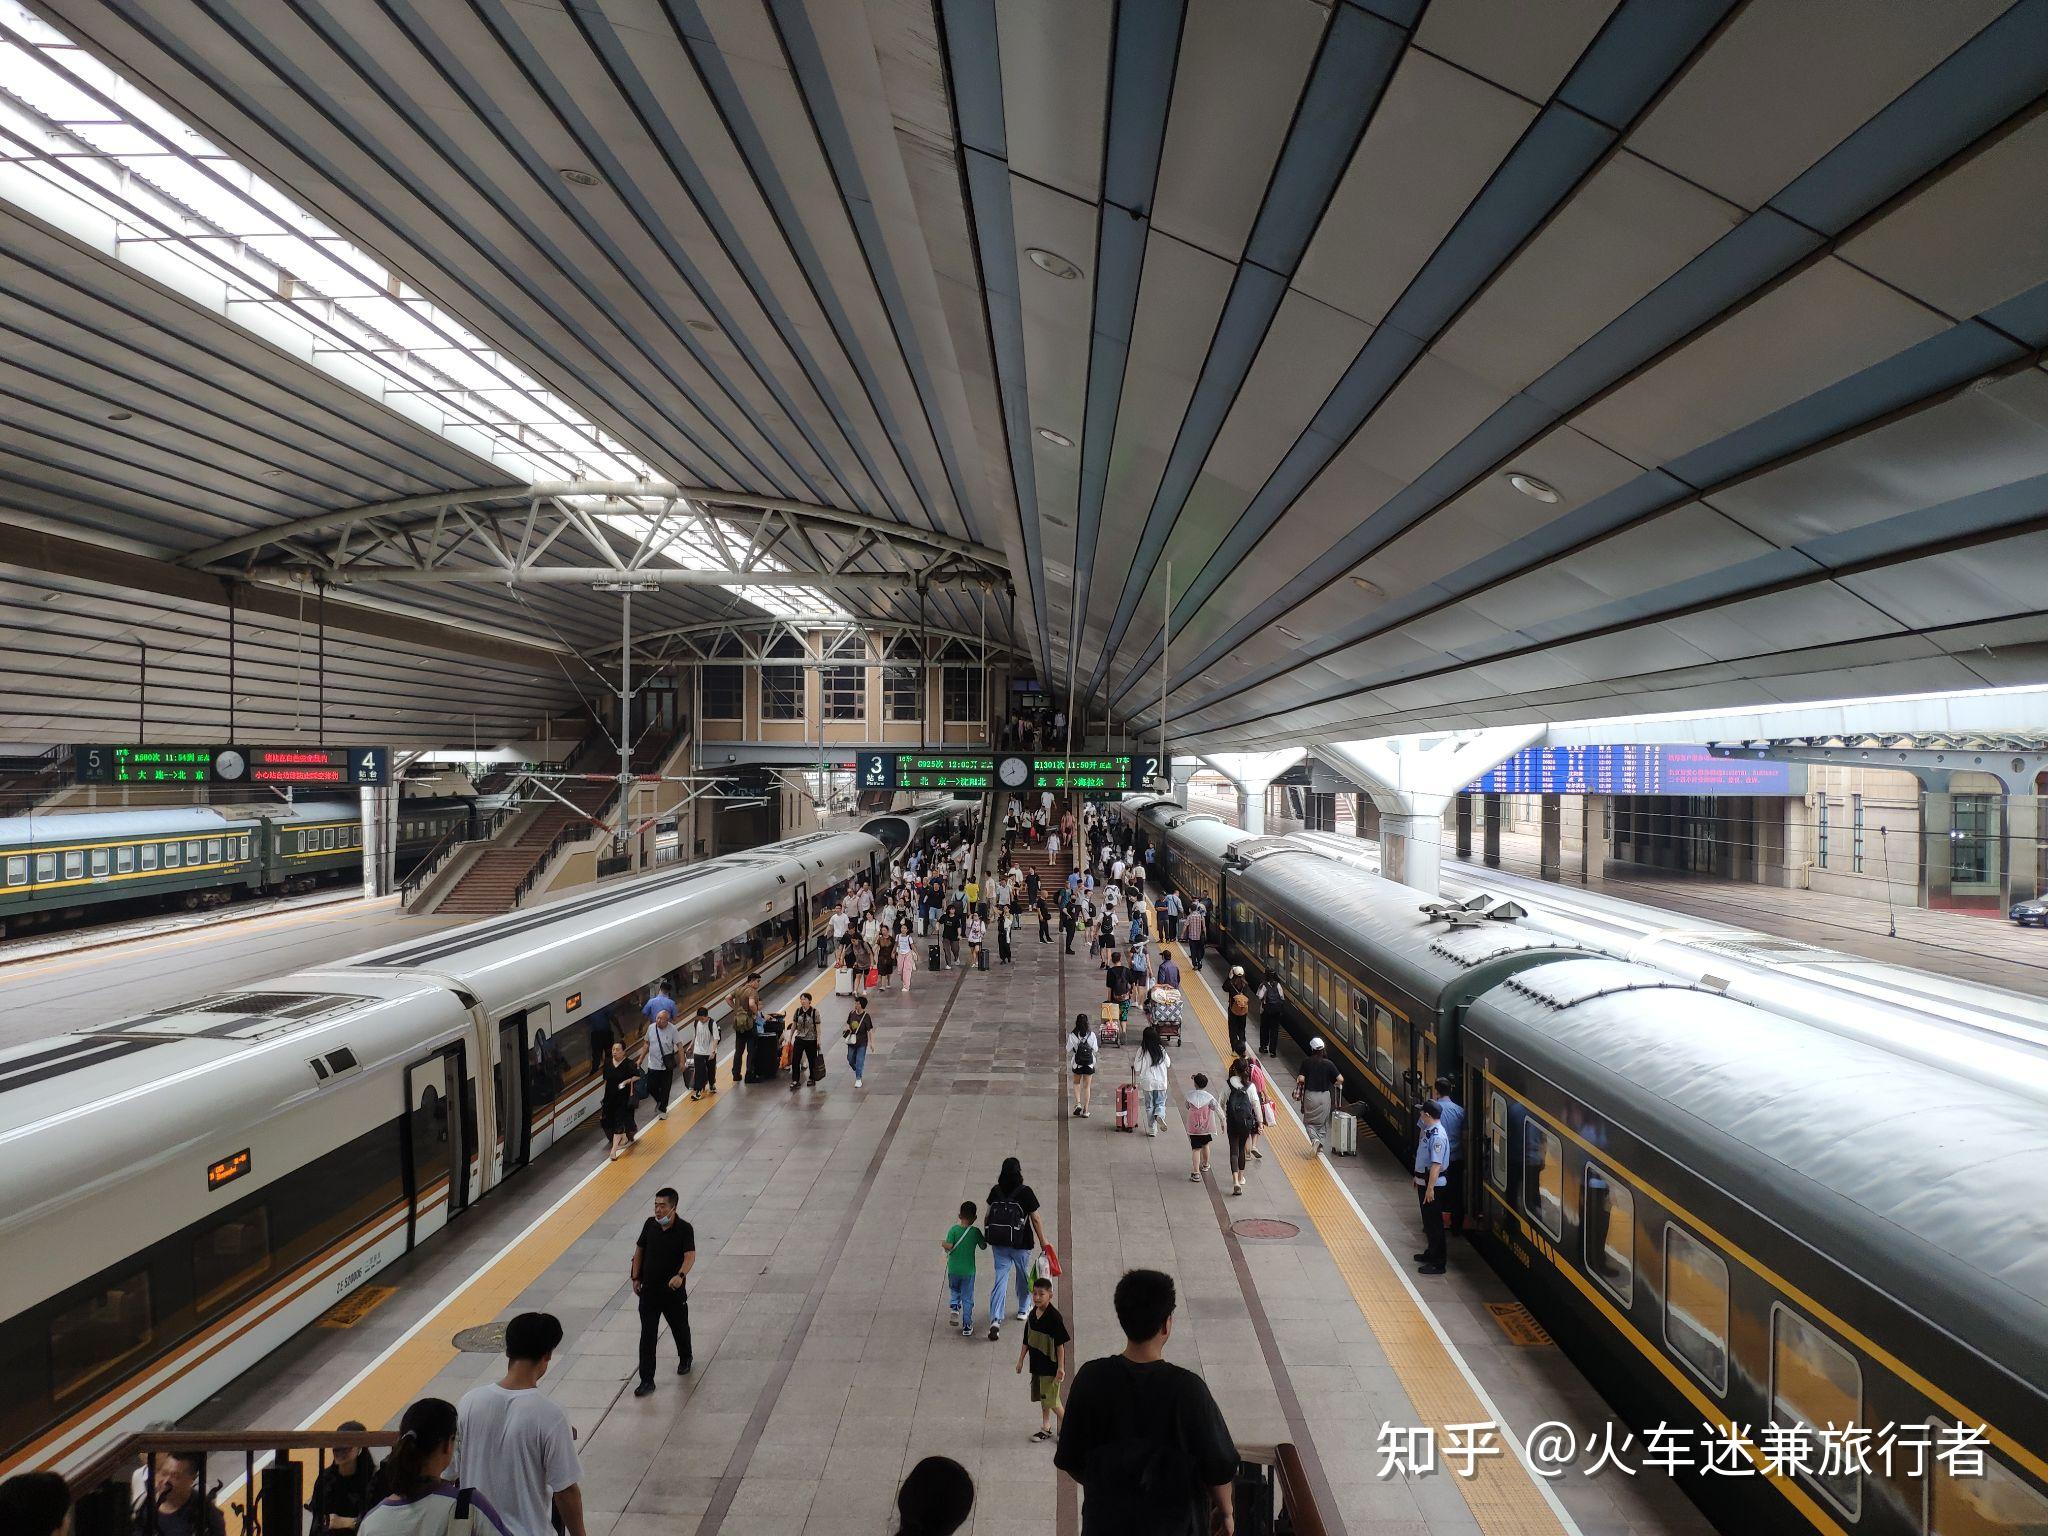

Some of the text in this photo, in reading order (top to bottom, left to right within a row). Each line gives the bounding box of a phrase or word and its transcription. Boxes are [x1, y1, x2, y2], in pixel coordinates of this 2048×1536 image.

[88, 750, 100, 767] 5
[361, 751, 376, 770] 4
[870, 756, 882, 774] 3
[1145, 758, 1158, 775] 2
[866, 773, 885, 782] 站台
